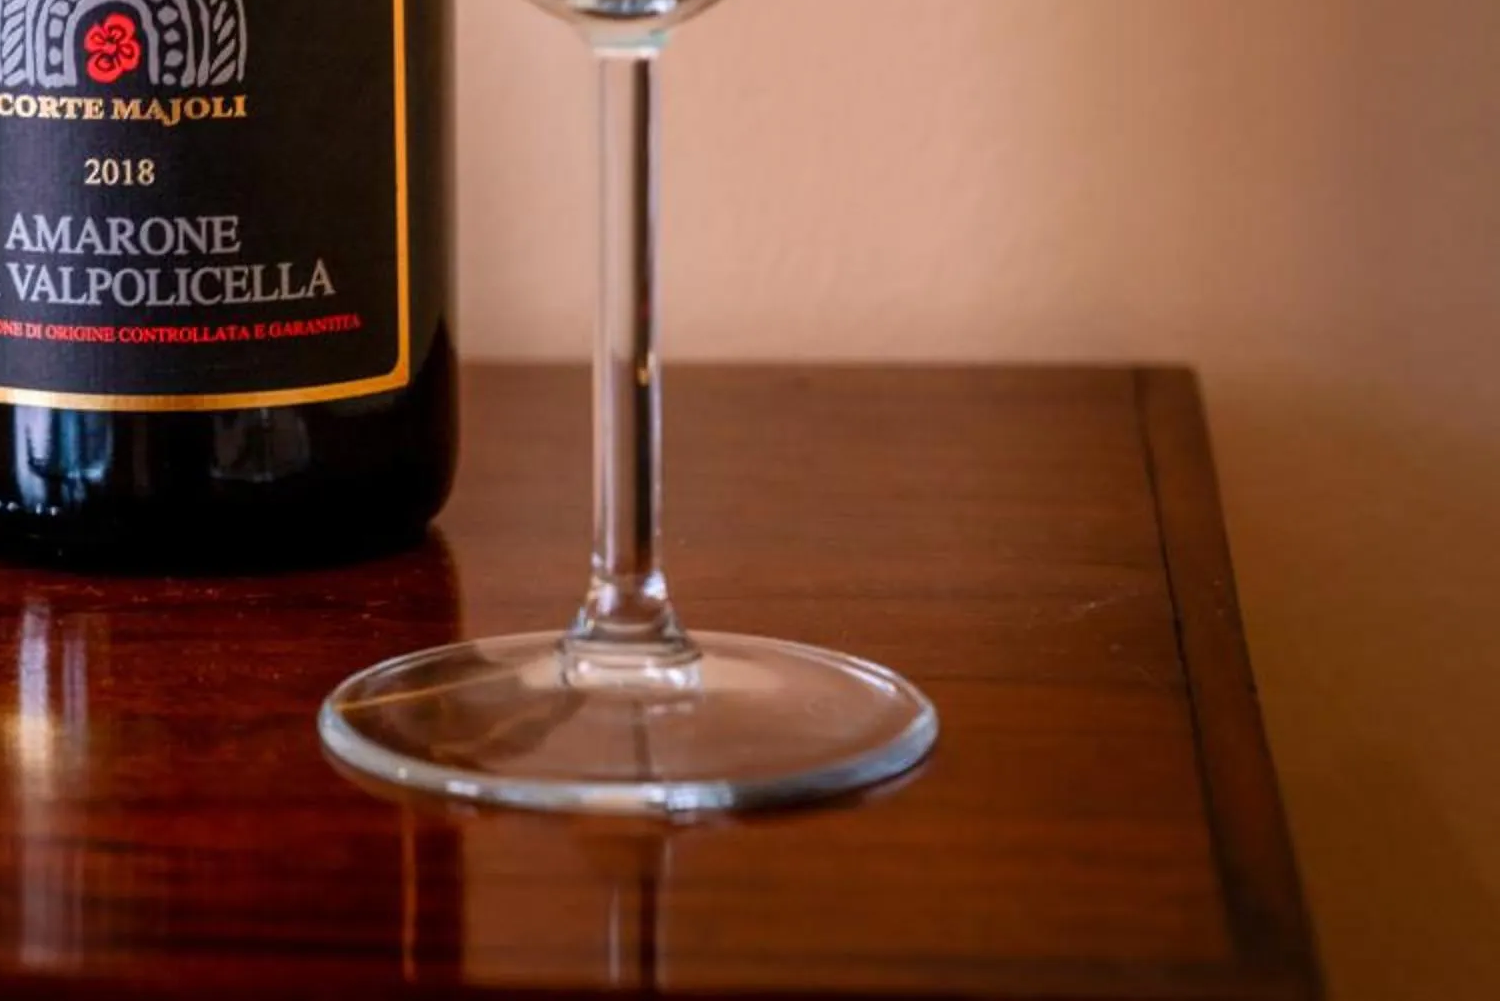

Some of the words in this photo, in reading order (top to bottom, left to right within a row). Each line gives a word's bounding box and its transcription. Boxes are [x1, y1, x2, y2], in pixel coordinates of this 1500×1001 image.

[110, 95, 248, 127] MAJOLI
[84, 159, 155, 186] 2018
[4, 212, 241, 256] AMARONE
[5, 259, 336, 307] VALPOLICELLA
[25, 322, 42, 339] DI
[45, 324, 116, 343] ORIGINE
[118, 325, 250, 345] CONTROLLATA
[254, 322, 267, 339] E
[269, 313, 362, 338] GARANTITA
